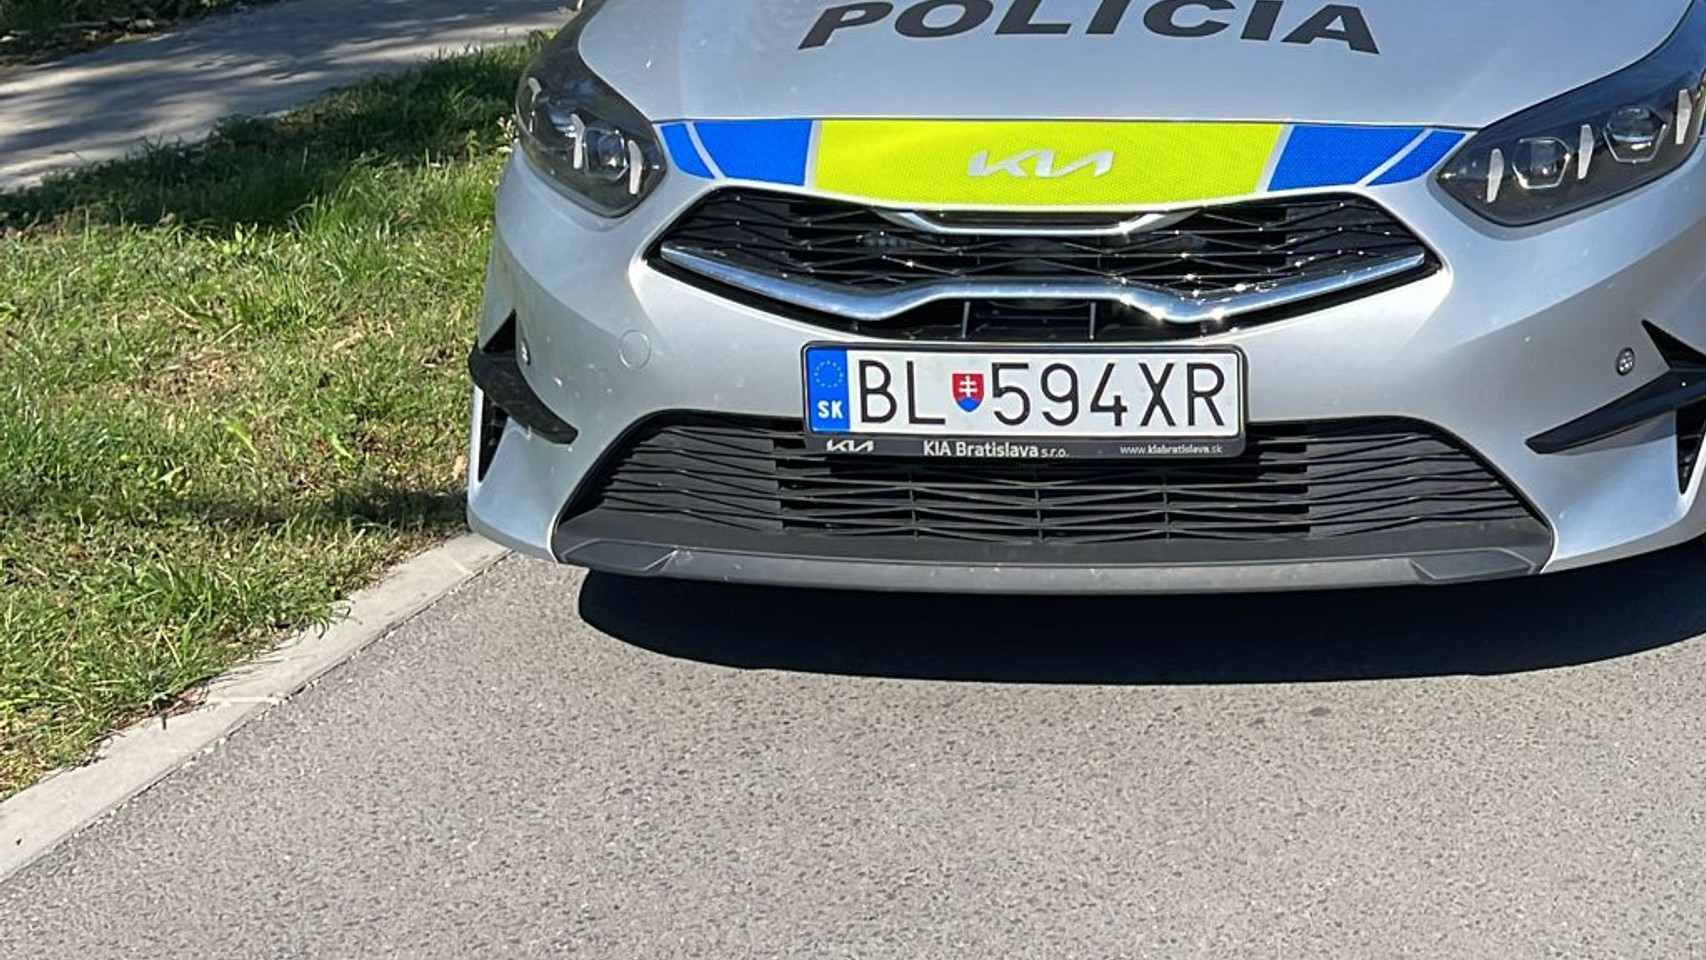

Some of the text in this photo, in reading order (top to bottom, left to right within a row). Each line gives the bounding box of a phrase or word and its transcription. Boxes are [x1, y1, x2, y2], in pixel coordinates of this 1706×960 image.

[858, 359, 1226, 427] BL 594XR
[817, 400, 843, 419] SK
[923, 441, 1070, 458] KIA Bratislava s.r.o.
